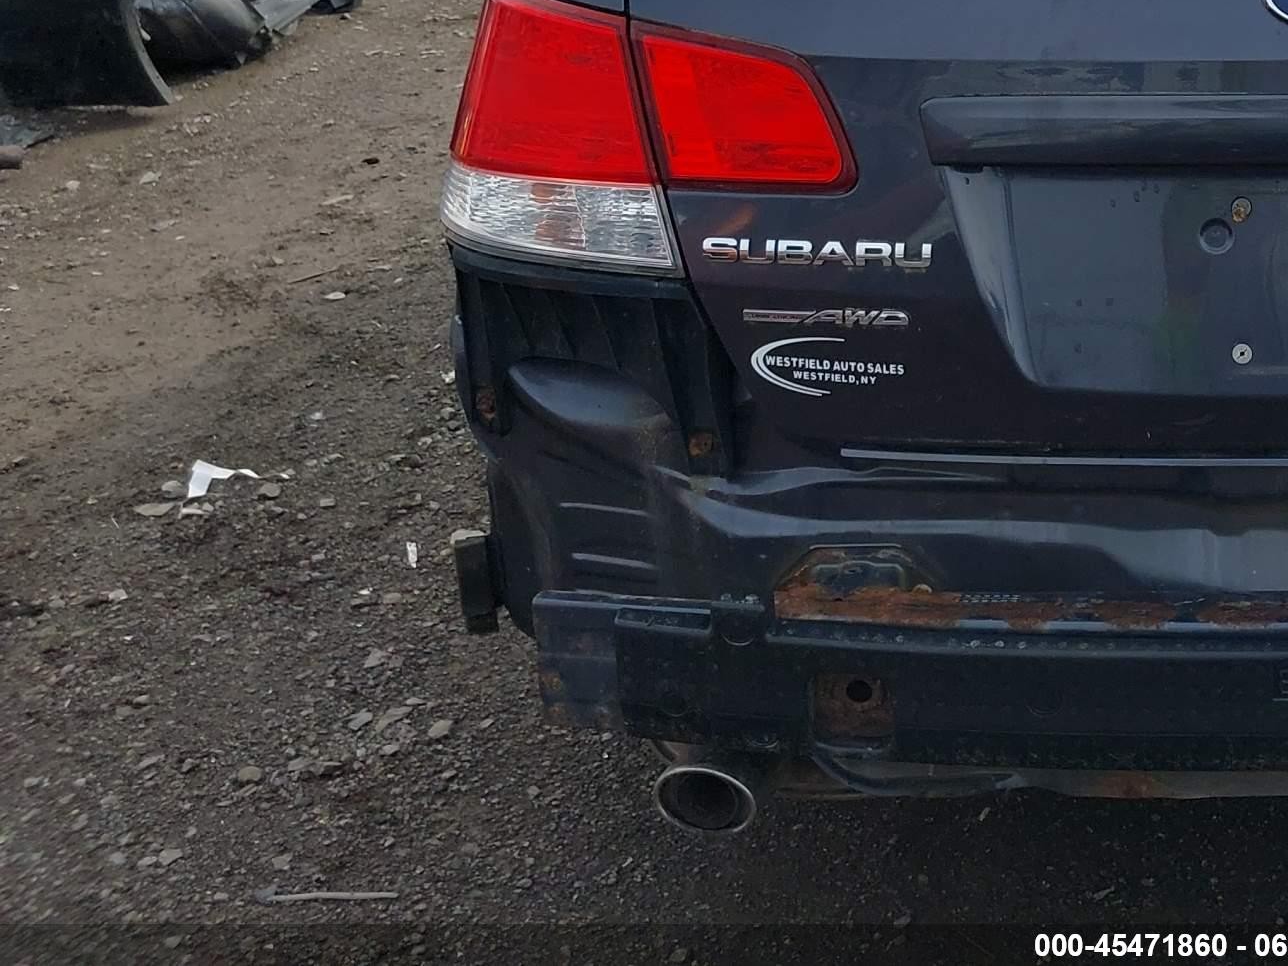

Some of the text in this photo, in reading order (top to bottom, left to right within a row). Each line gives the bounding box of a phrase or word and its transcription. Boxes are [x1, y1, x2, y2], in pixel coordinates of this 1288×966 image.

[702, 236, 933, 269] SUBARU
[803, 307, 911, 326] AWD
[765, 354, 905, 375] WESTFIELD AUTO SALES
